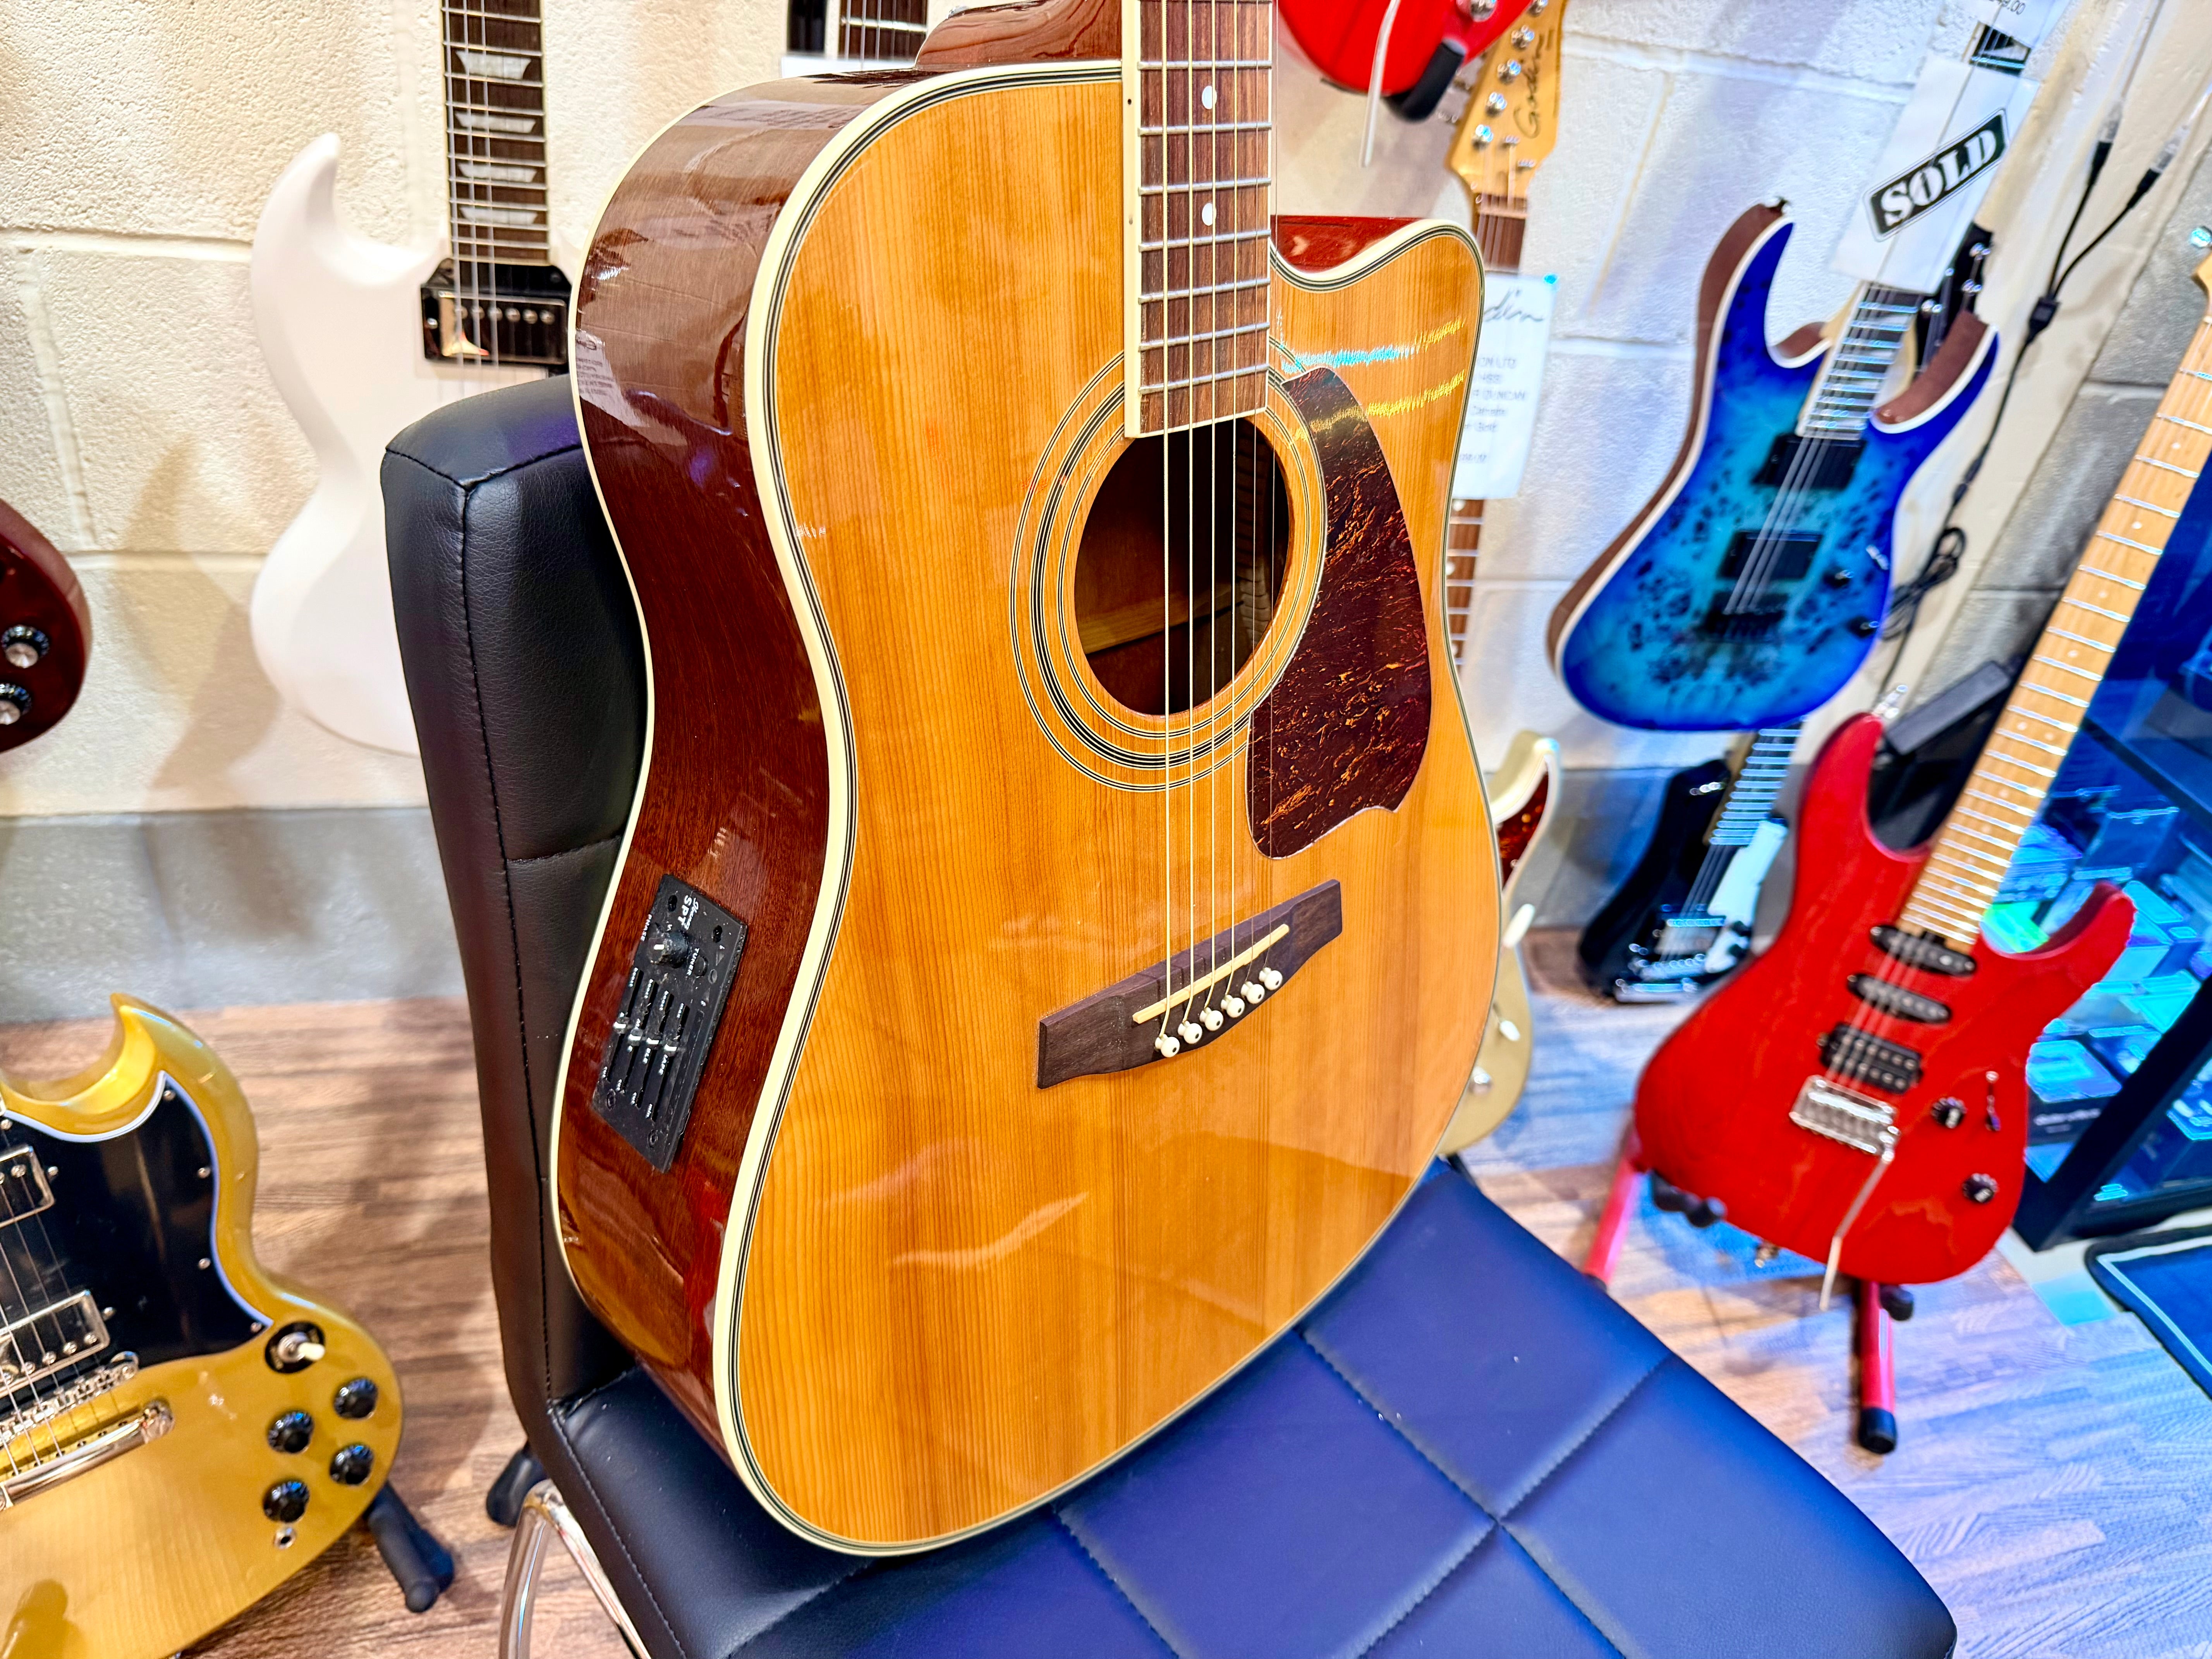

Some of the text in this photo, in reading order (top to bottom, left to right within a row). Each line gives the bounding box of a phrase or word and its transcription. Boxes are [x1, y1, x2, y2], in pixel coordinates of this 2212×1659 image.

[1881, 130, 1996, 226] SOLD
[678, 895, 692, 926] SPT
[641, 914, 652, 941] PHASE
[687, 948, 700, 975] TUNER
